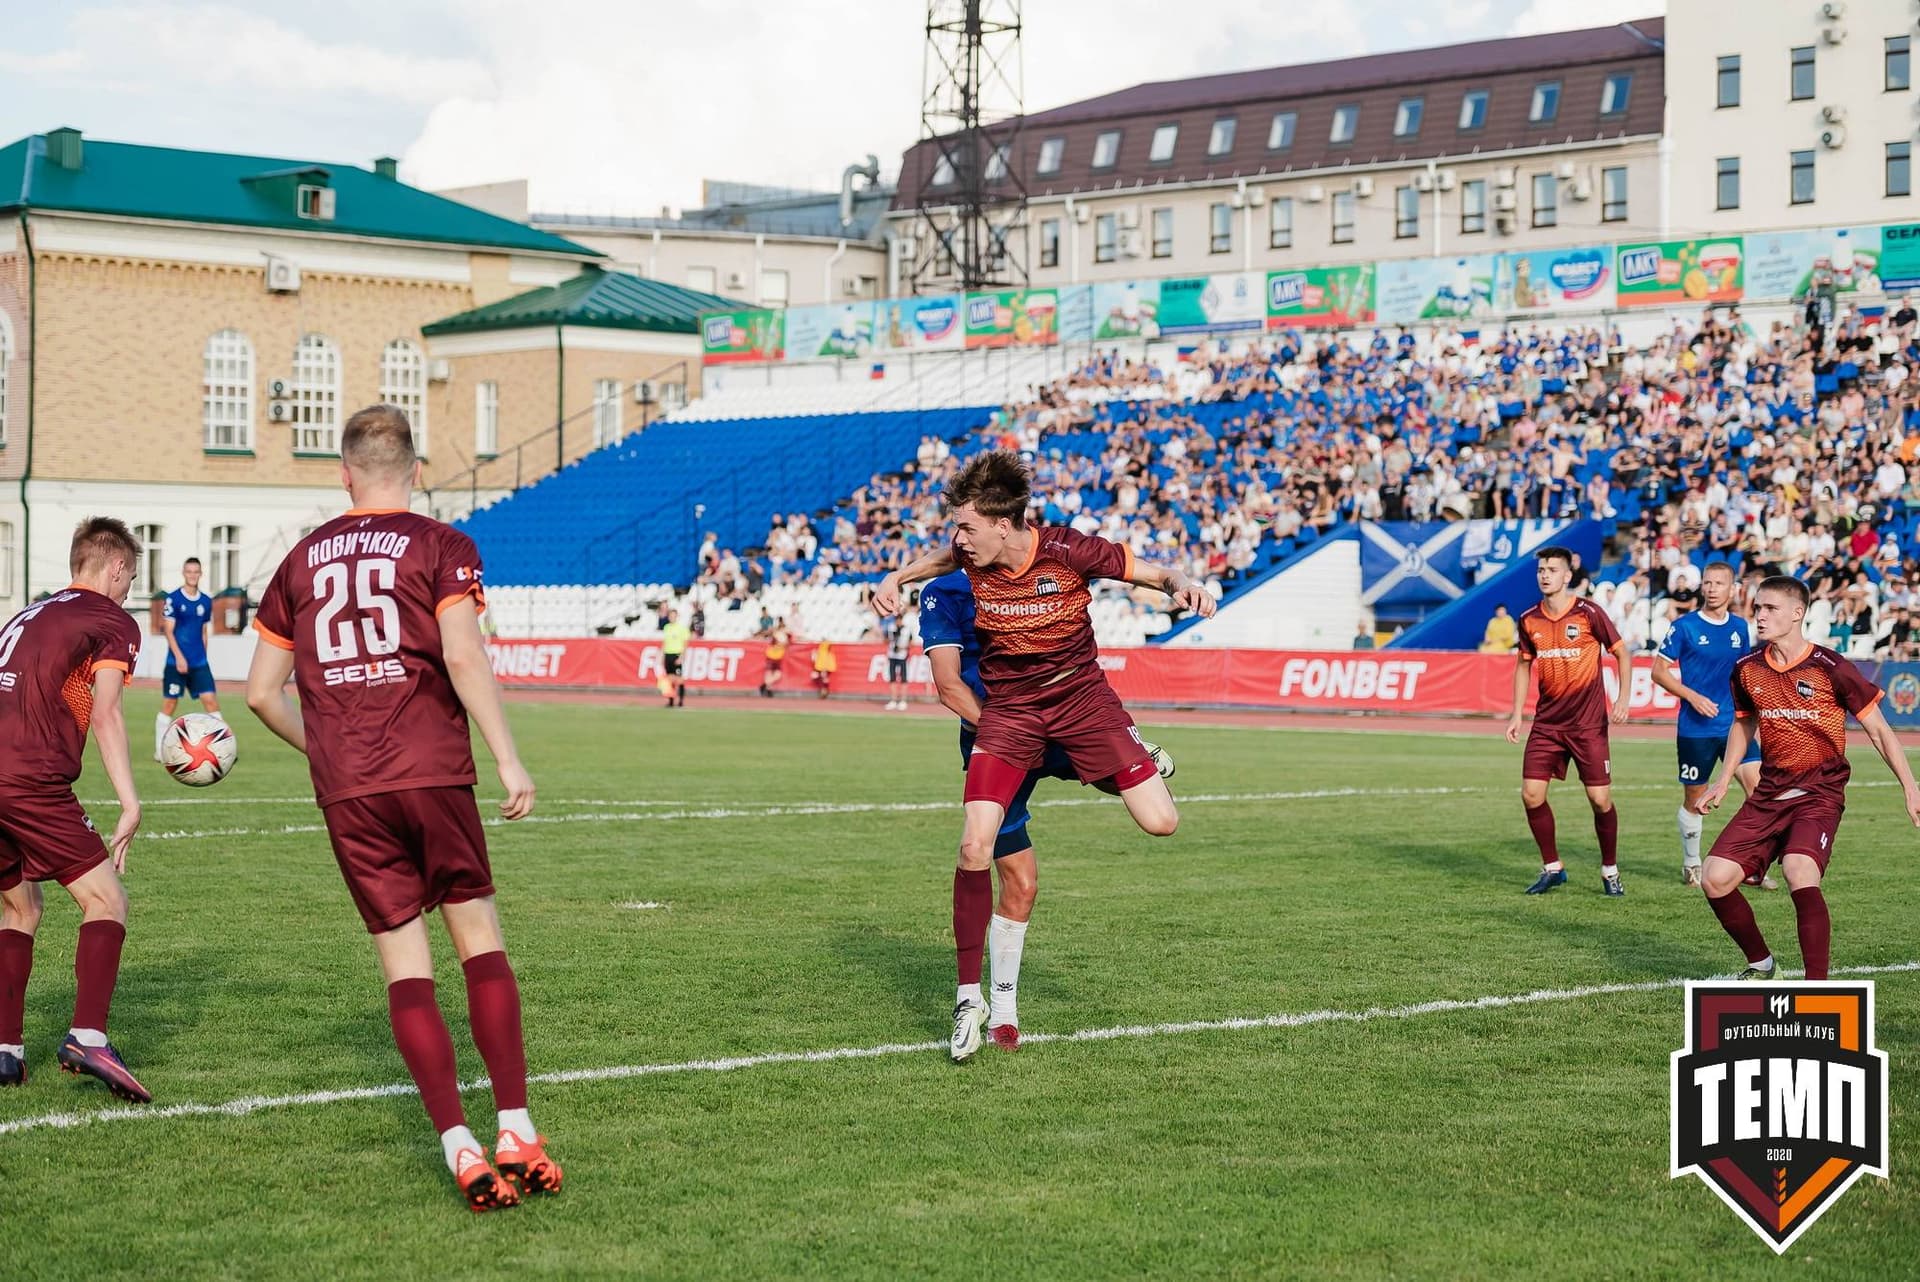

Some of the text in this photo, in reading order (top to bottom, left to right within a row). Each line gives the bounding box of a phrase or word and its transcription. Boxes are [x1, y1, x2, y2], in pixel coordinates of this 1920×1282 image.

[307, 531, 410, 568] НОВИЧКОВ
[312, 558, 400, 663] 25
[323, 659, 406, 686] SEUS
[483, 644, 566, 677] ONBET
[638, 646, 745, 681] FBET
[1279, 658, 1428, 700] FONBET
[1681, 763, 1699, 780] 20
[1820, 832, 1828, 849] 4
